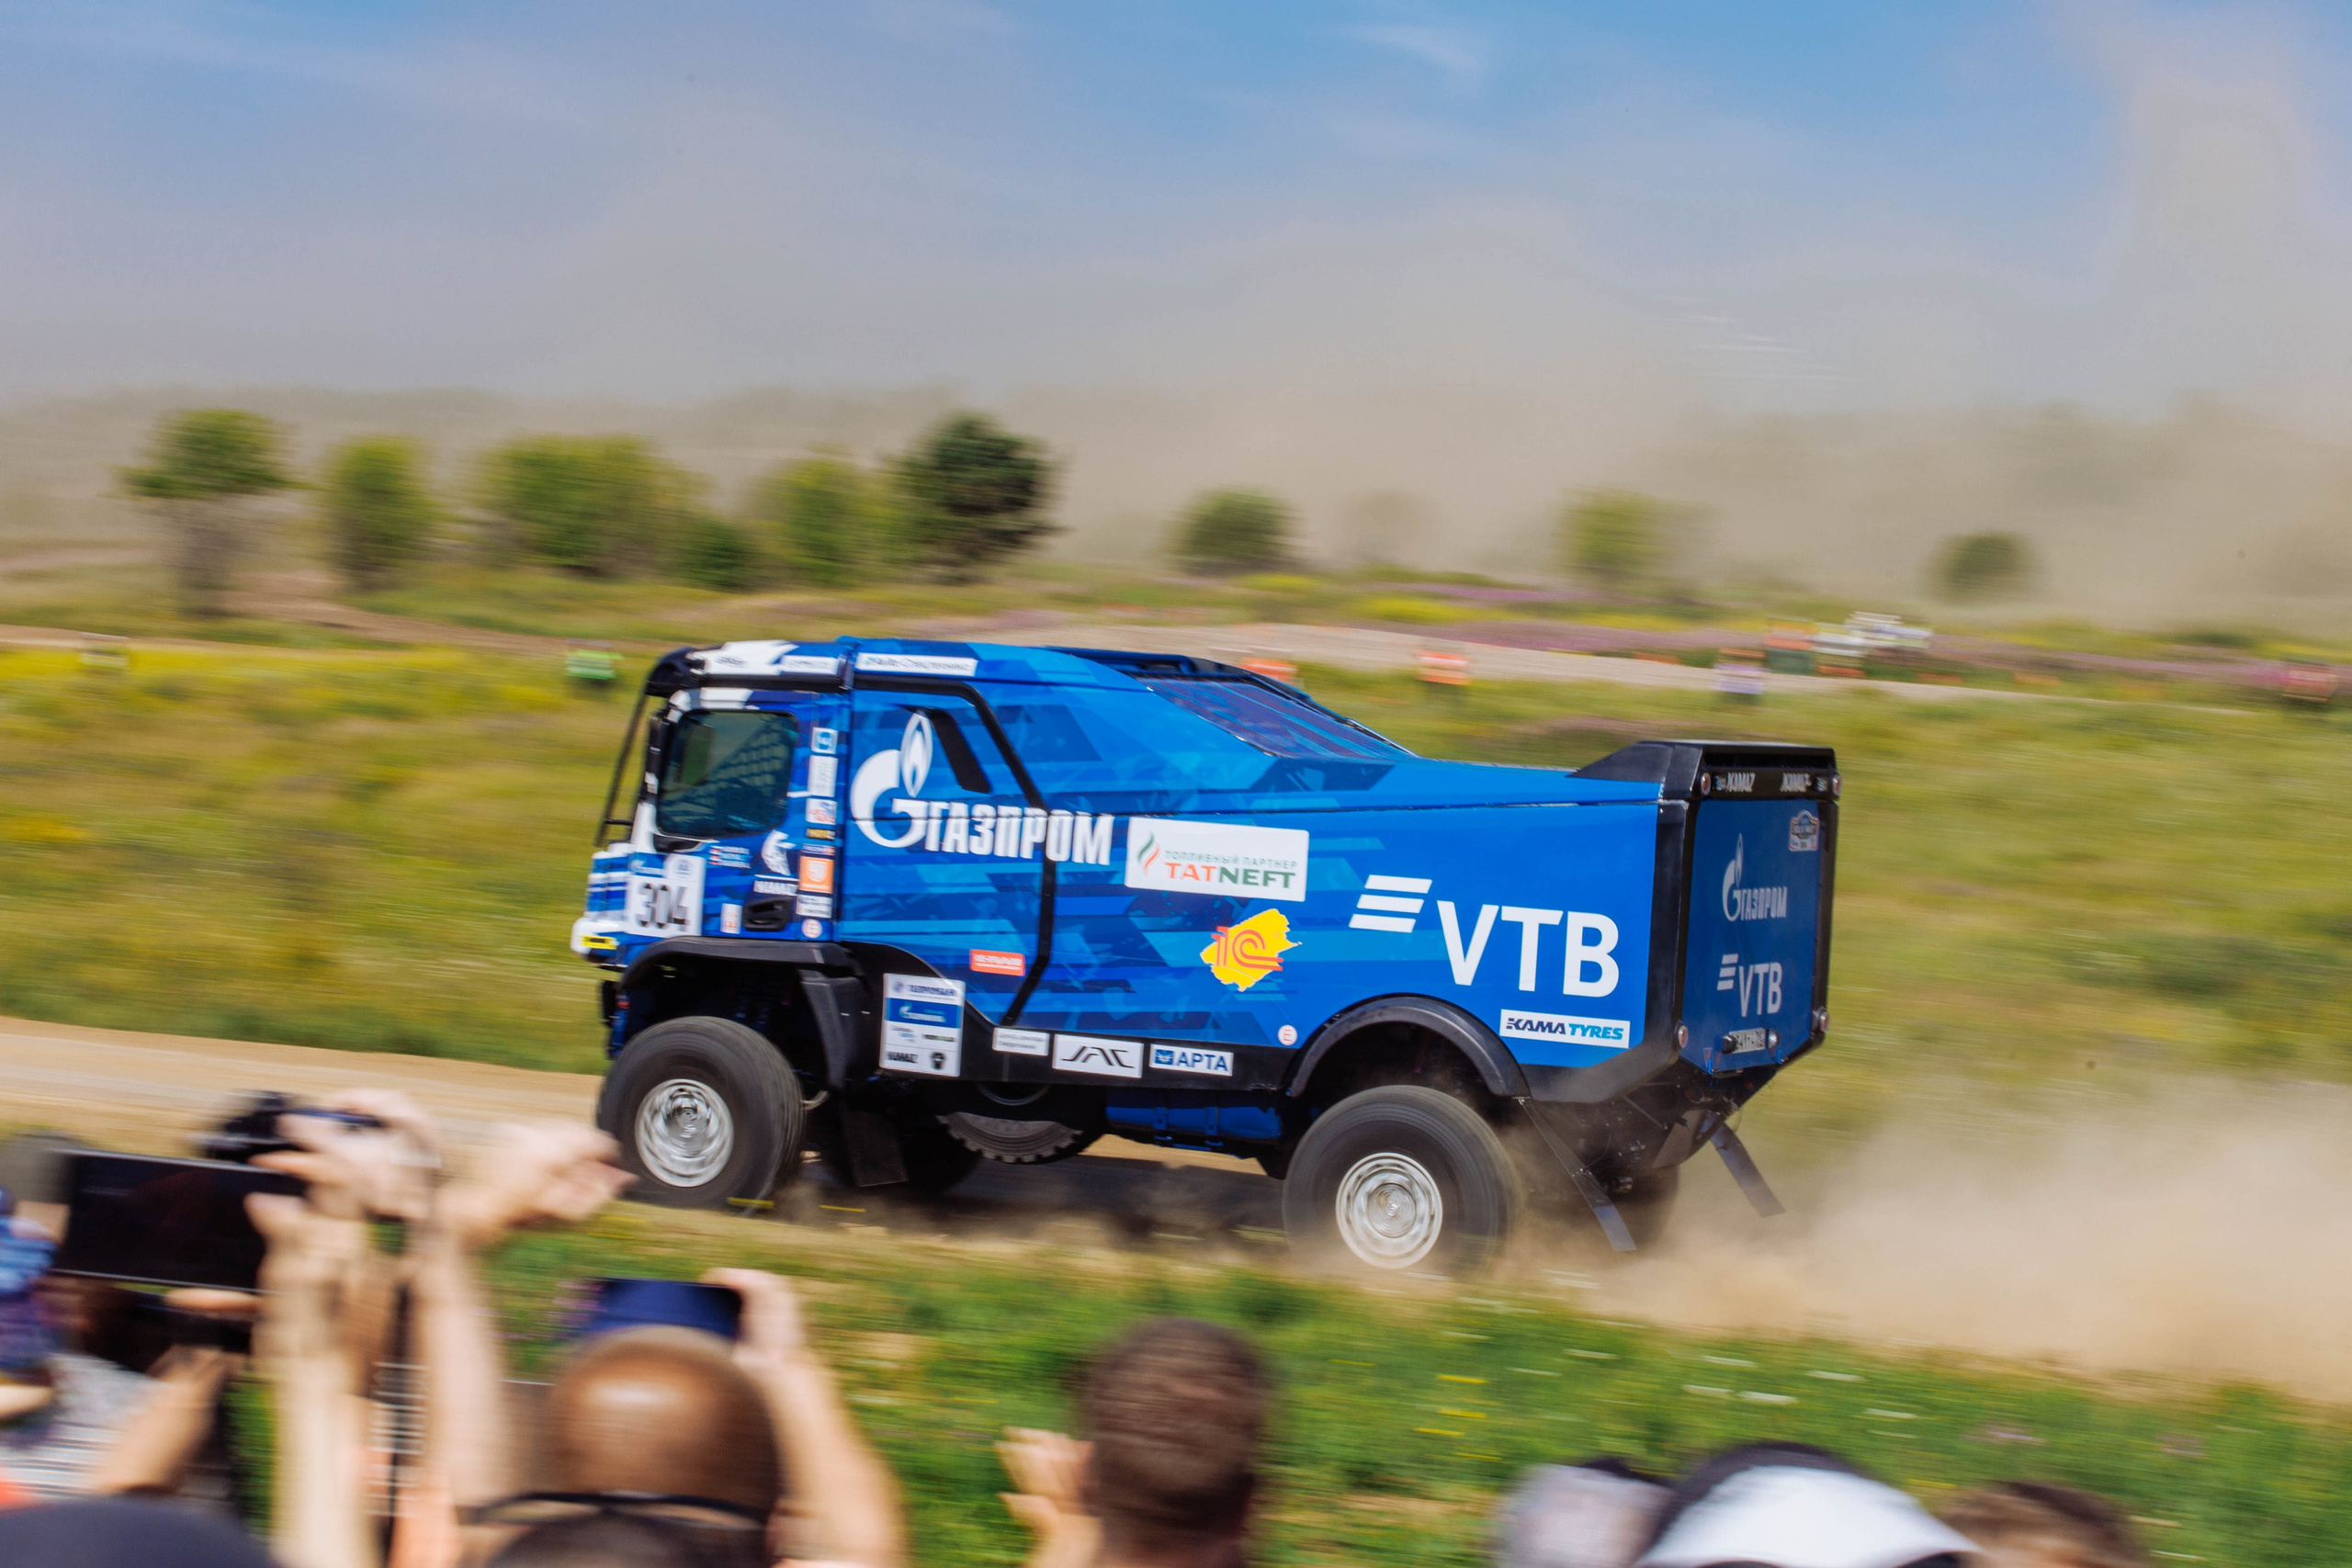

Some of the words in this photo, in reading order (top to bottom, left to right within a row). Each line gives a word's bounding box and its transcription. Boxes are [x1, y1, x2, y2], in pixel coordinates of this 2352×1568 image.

[925, 801, 1115, 865] ГАЗПРОМ
[1165, 862, 1296, 888] TATNEFT
[1741, 886, 1788, 920] ГАЗПРОМ
[1436, 900, 1620, 998] VTB
[1739, 963, 1782, 1018] VTB
[1506, 1017, 1566, 1034] KAMA
[1568, 1022, 1624, 1040] TYRES
